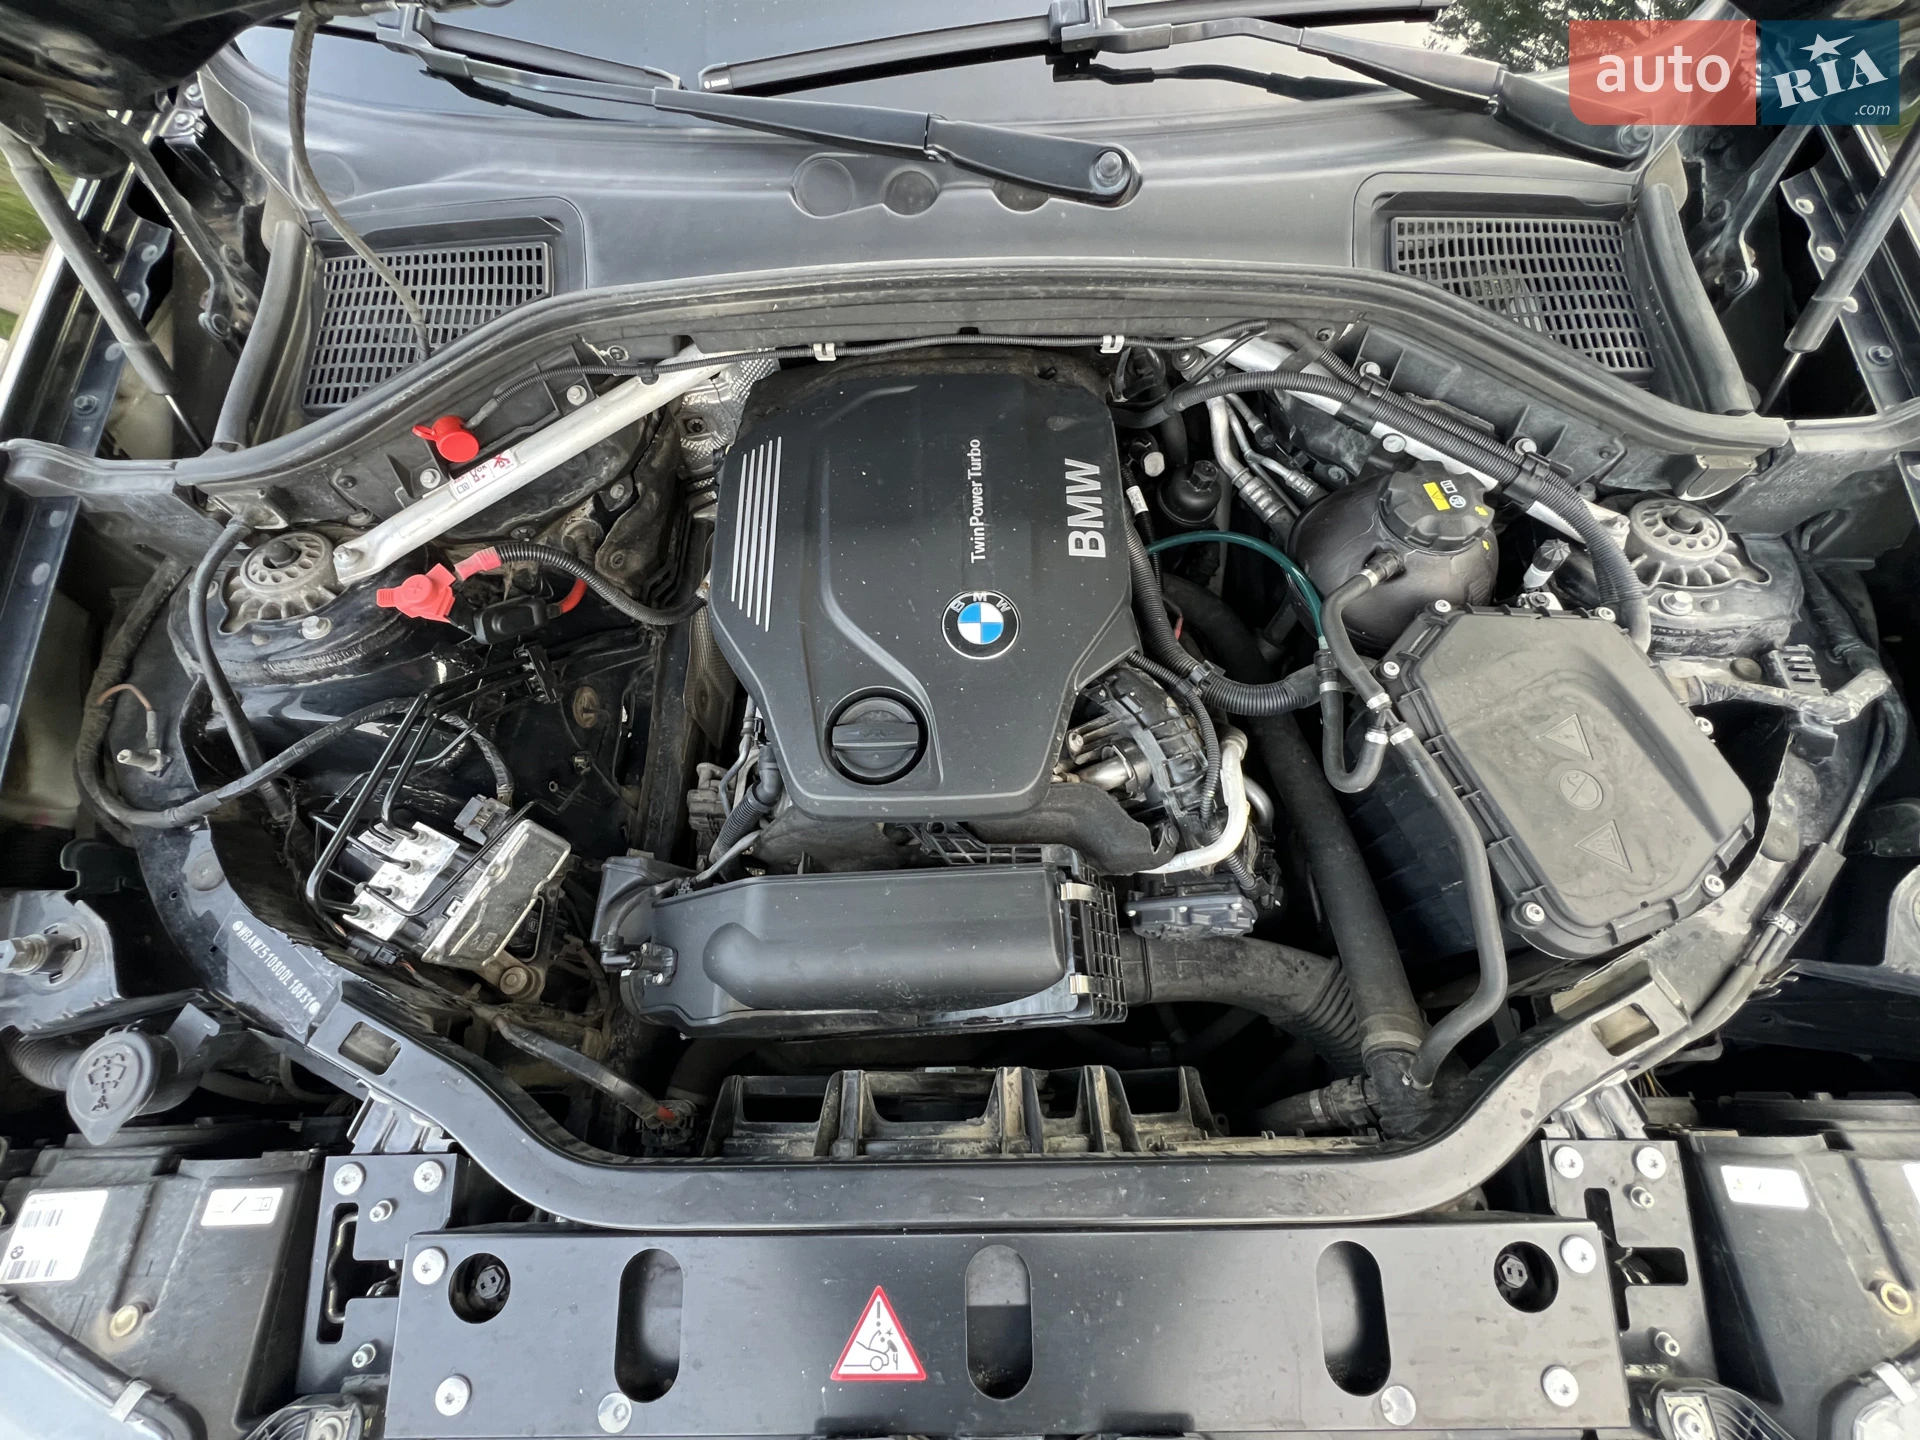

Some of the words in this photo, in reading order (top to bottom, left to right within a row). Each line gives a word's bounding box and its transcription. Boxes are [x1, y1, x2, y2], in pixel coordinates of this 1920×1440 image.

[967, 438, 982, 480] Turbo
[969, 480, 986, 564] TwinPower
[1064, 458, 1106, 558] BMW
[950, 592, 1011, 613] BMW
